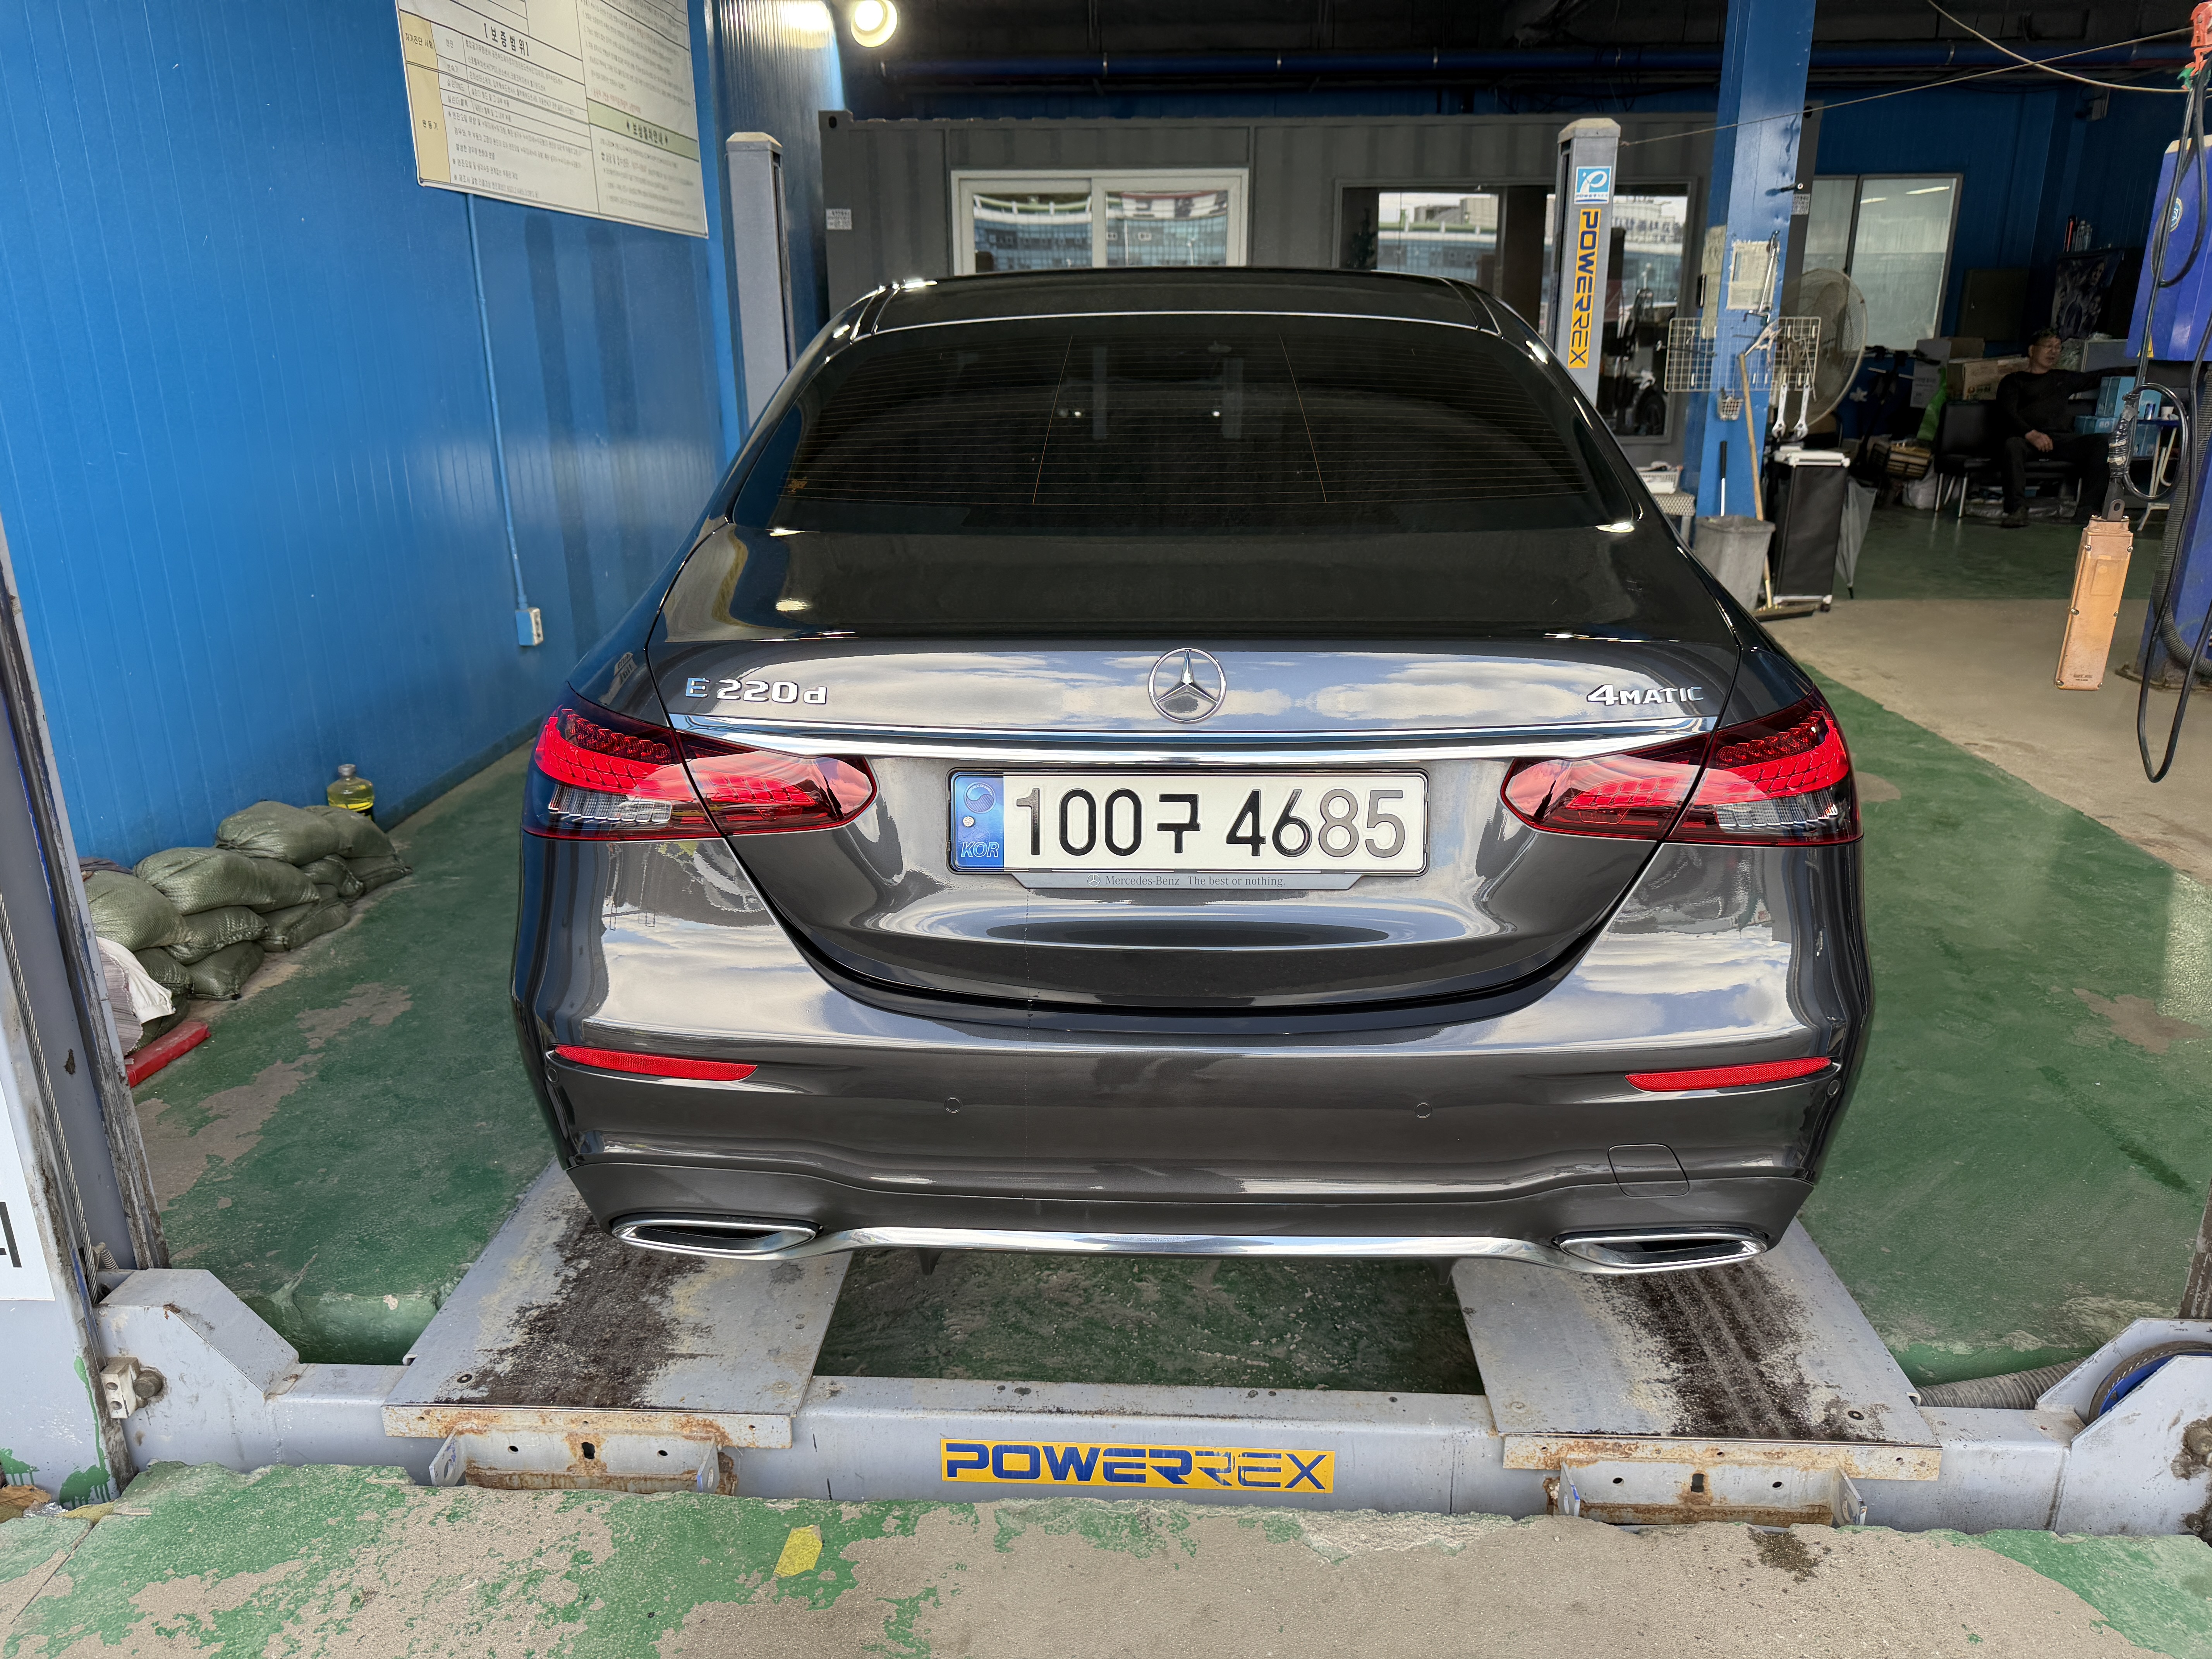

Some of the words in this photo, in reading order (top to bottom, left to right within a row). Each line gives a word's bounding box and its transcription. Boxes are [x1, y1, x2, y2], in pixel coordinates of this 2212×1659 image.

[405, 31, 423, 46] 자가진단
[1570, 211, 1599, 364] POWERREX
[685, 677, 711, 698] E
[1587, 684, 1704, 706] 4MATIC
[1016, 787, 1201, 857] 100구
[1226, 788, 1406, 857] 4685
[960, 841, 1000, 858] KOR
[1105, 876, 1180, 885] Mercedes-Benz
[1188, 876, 1207, 885] The
[1209, 876, 1229, 885] best
[946, 1442, 1328, 1490] POWERREX
